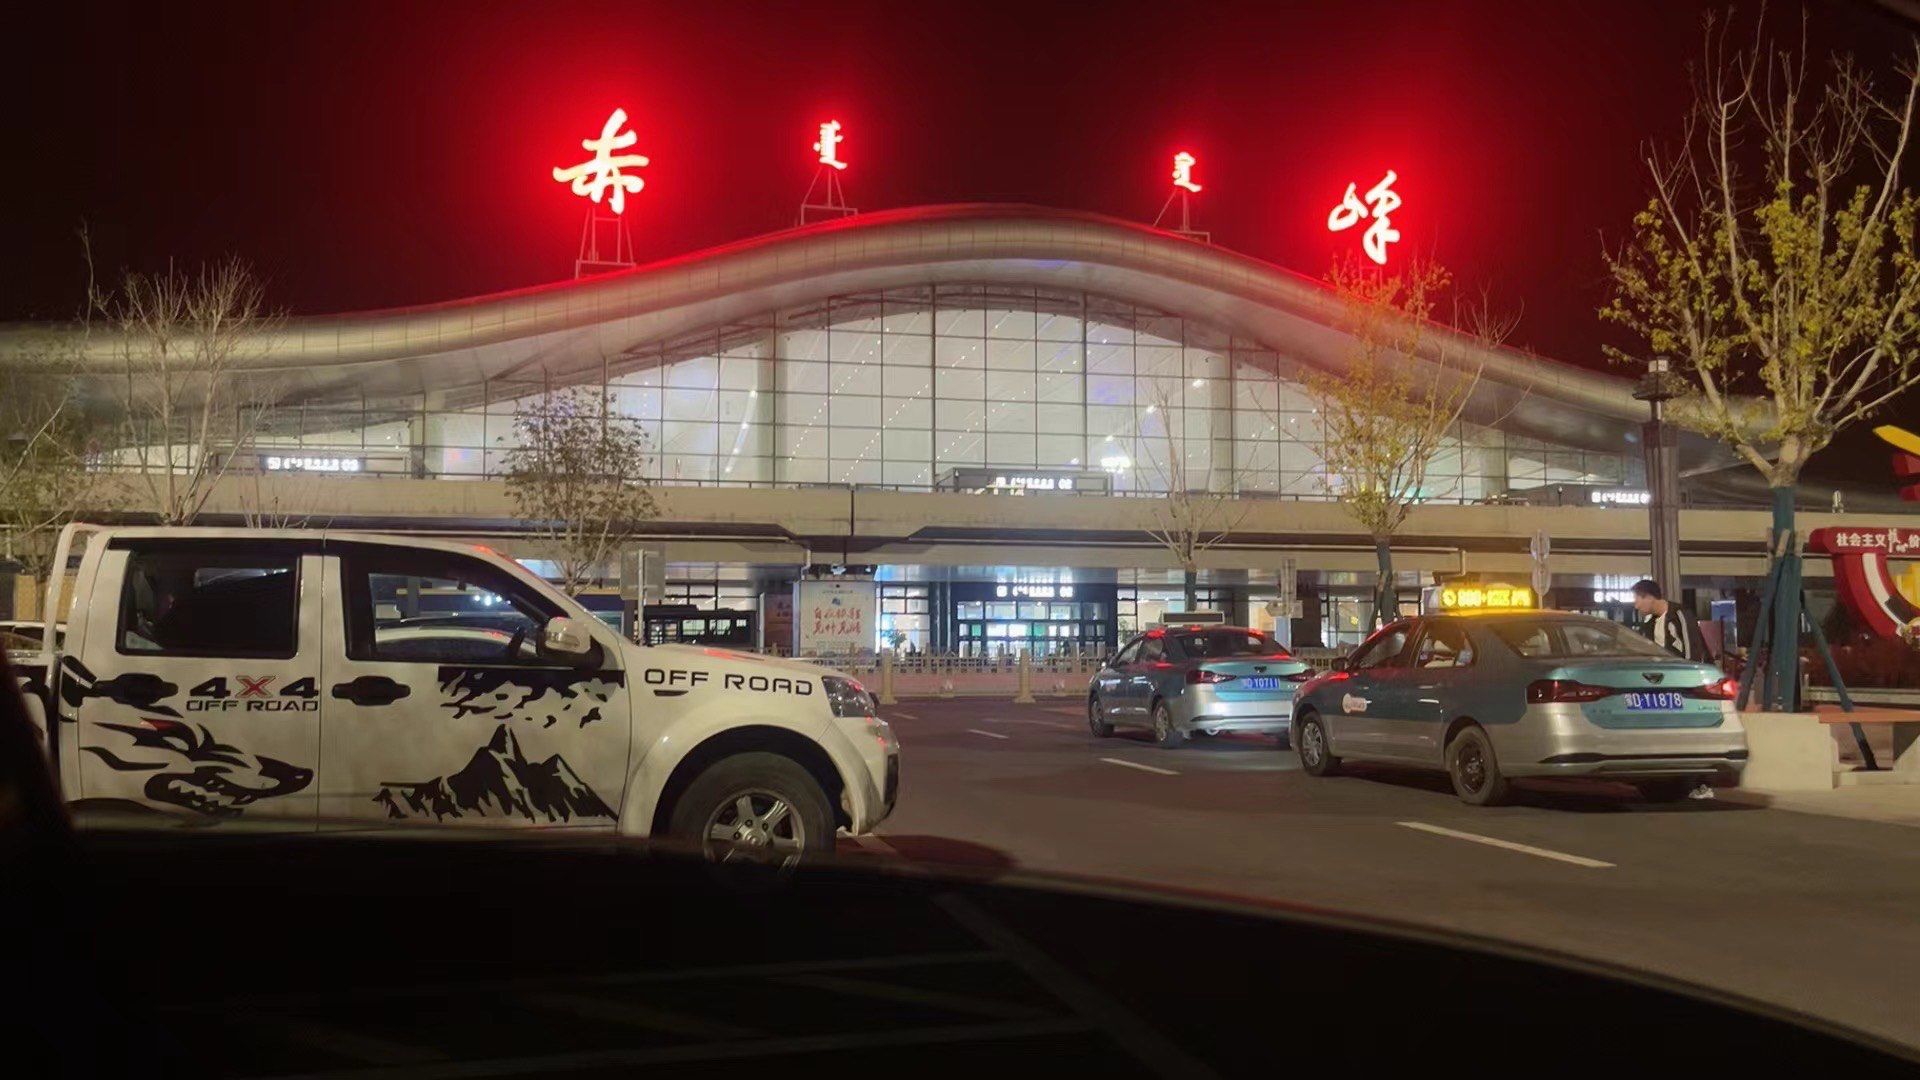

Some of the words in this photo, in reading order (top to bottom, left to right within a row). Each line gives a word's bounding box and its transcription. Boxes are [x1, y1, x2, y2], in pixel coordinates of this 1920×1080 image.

[552, 107, 650, 214] 赤
[1327, 169, 1402, 265] 峰
[189, 675, 320, 699] 4X4
[644, 668, 709, 687] OFF
[724, 673, 813, 696] ROAD
[186, 700, 239, 711] OFF
[246, 700, 318, 711] ROAD
